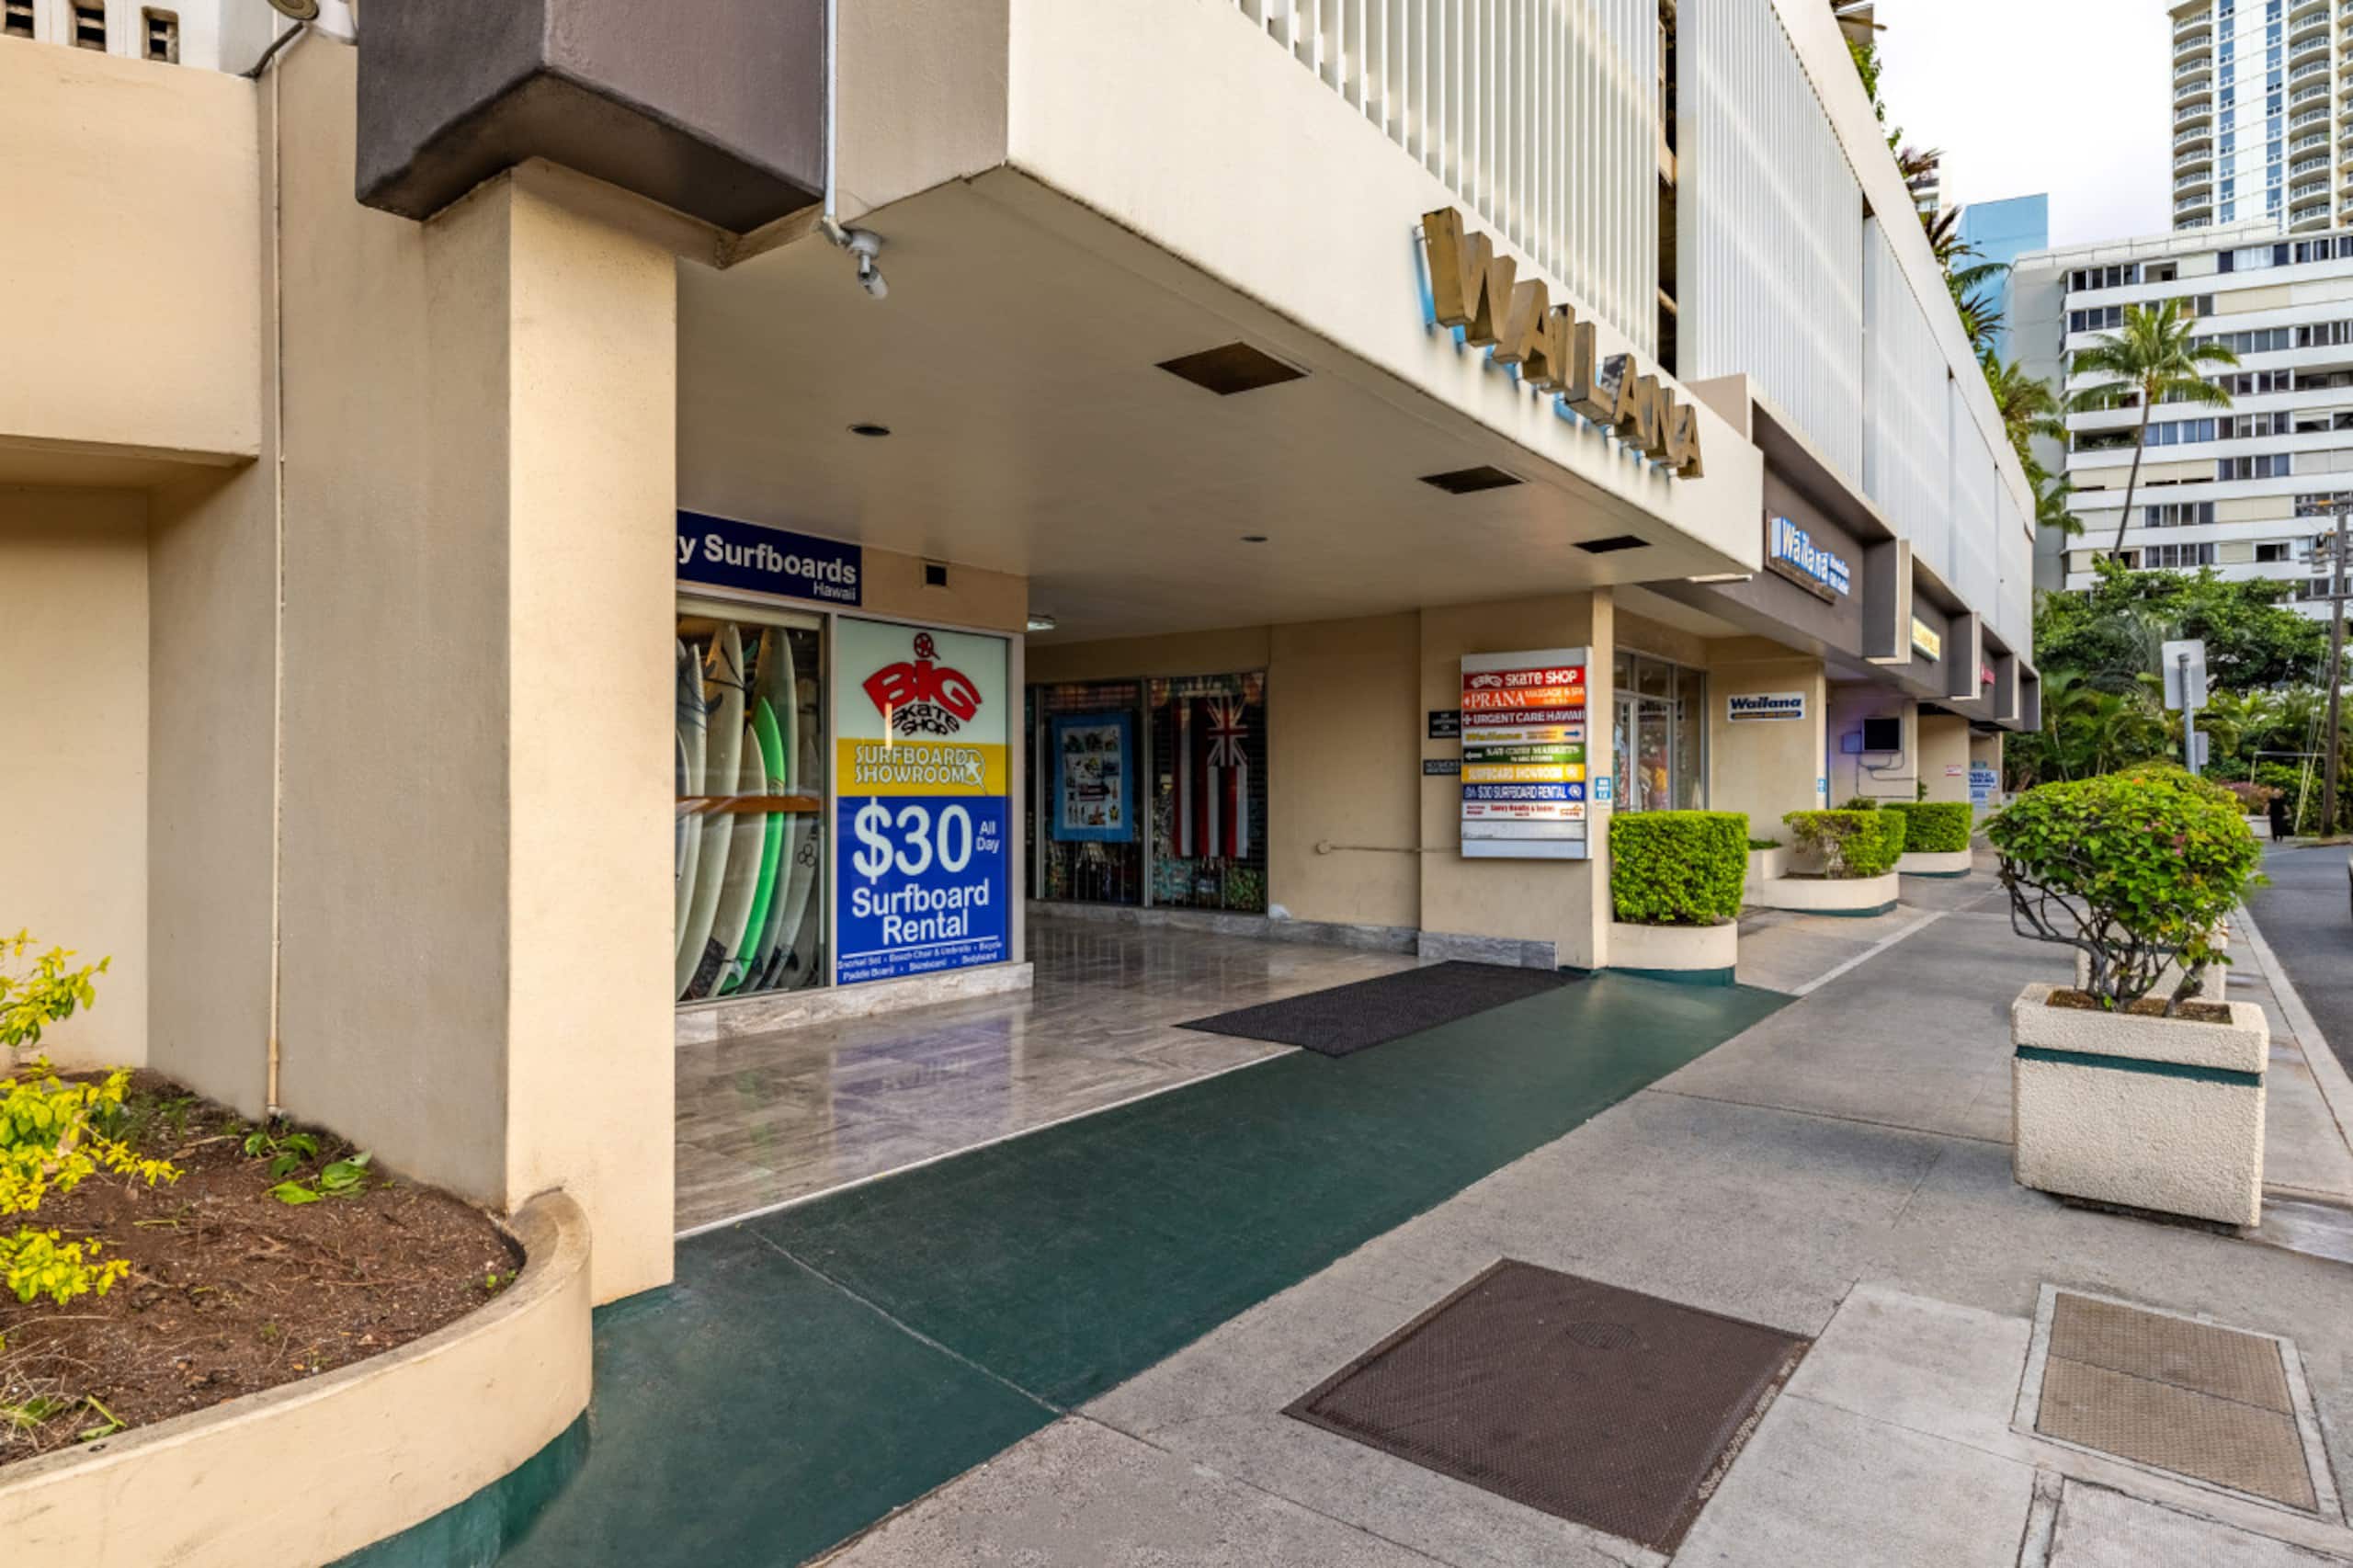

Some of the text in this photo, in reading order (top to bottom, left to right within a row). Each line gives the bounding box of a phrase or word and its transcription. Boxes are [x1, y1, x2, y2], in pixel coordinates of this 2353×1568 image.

[1420, 206, 1704, 479] WAILANA
[704, 534, 857, 585] Surfboards
[813, 580, 856, 602] Hawaii
[1545, 669, 1578, 685] SHOP
[862, 660, 983, 722] BIG
[1471, 690, 1526, 709] PRANA
[1730, 697, 1802, 710] Wailana
[1473, 712, 1516, 724] URGENT
[1517, 710, 1545, 722] CARE
[902, 719, 948, 736] SHOP
[855, 744, 968, 767] SURFBOARD
[855, 765, 966, 784] SHOWROOM
[1494, 785, 1537, 799] SURFBOARD
[1538, 785, 1567, 799] RENTAL
[980, 821, 996, 835] All
[852, 796, 973, 885] $30
[976, 837, 1000, 854] Day
[852, 878, 990, 918] Surfboard
[882, 908, 968, 946] Rental
